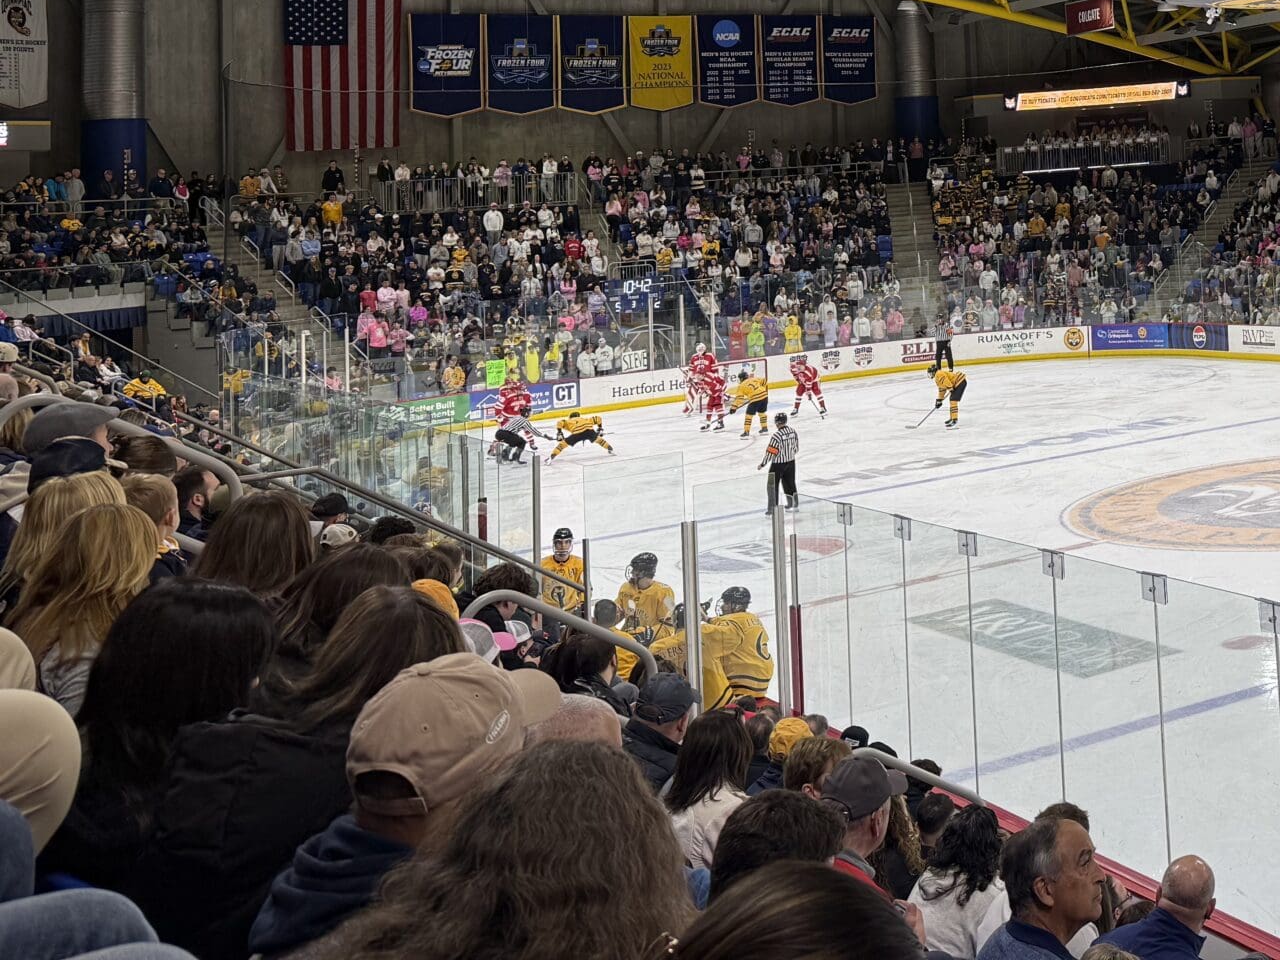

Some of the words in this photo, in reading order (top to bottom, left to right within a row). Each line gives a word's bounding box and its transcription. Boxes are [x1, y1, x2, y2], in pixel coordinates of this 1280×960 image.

[1078, 7, 1100, 24] COLGATE
[771, 27, 811, 36] ECAC
[831, 28, 871, 37] ECAC
[715, 33, 740, 41] NCAA
[427, 48, 474, 60] FROZEN
[497, 58, 525, 68] FROZEN
[526, 58, 545, 68] FOUR
[569, 59, 597, 68] FROZEN
[598, 59, 617, 68] FOUR
[651, 63, 672, 71] 2023
[638, 72, 686, 80] NATIONAL
[634, 80, 690, 89] CHAMPIONS
[623, 279, 652, 294] 10:42
[977, 330, 1054, 344] RUMANOFF'S
[612, 372, 665, 398] Hartford
[554, 385, 575, 400] CT
[409, 403, 435, 413] Better
[436, 400, 455, 411] Built
